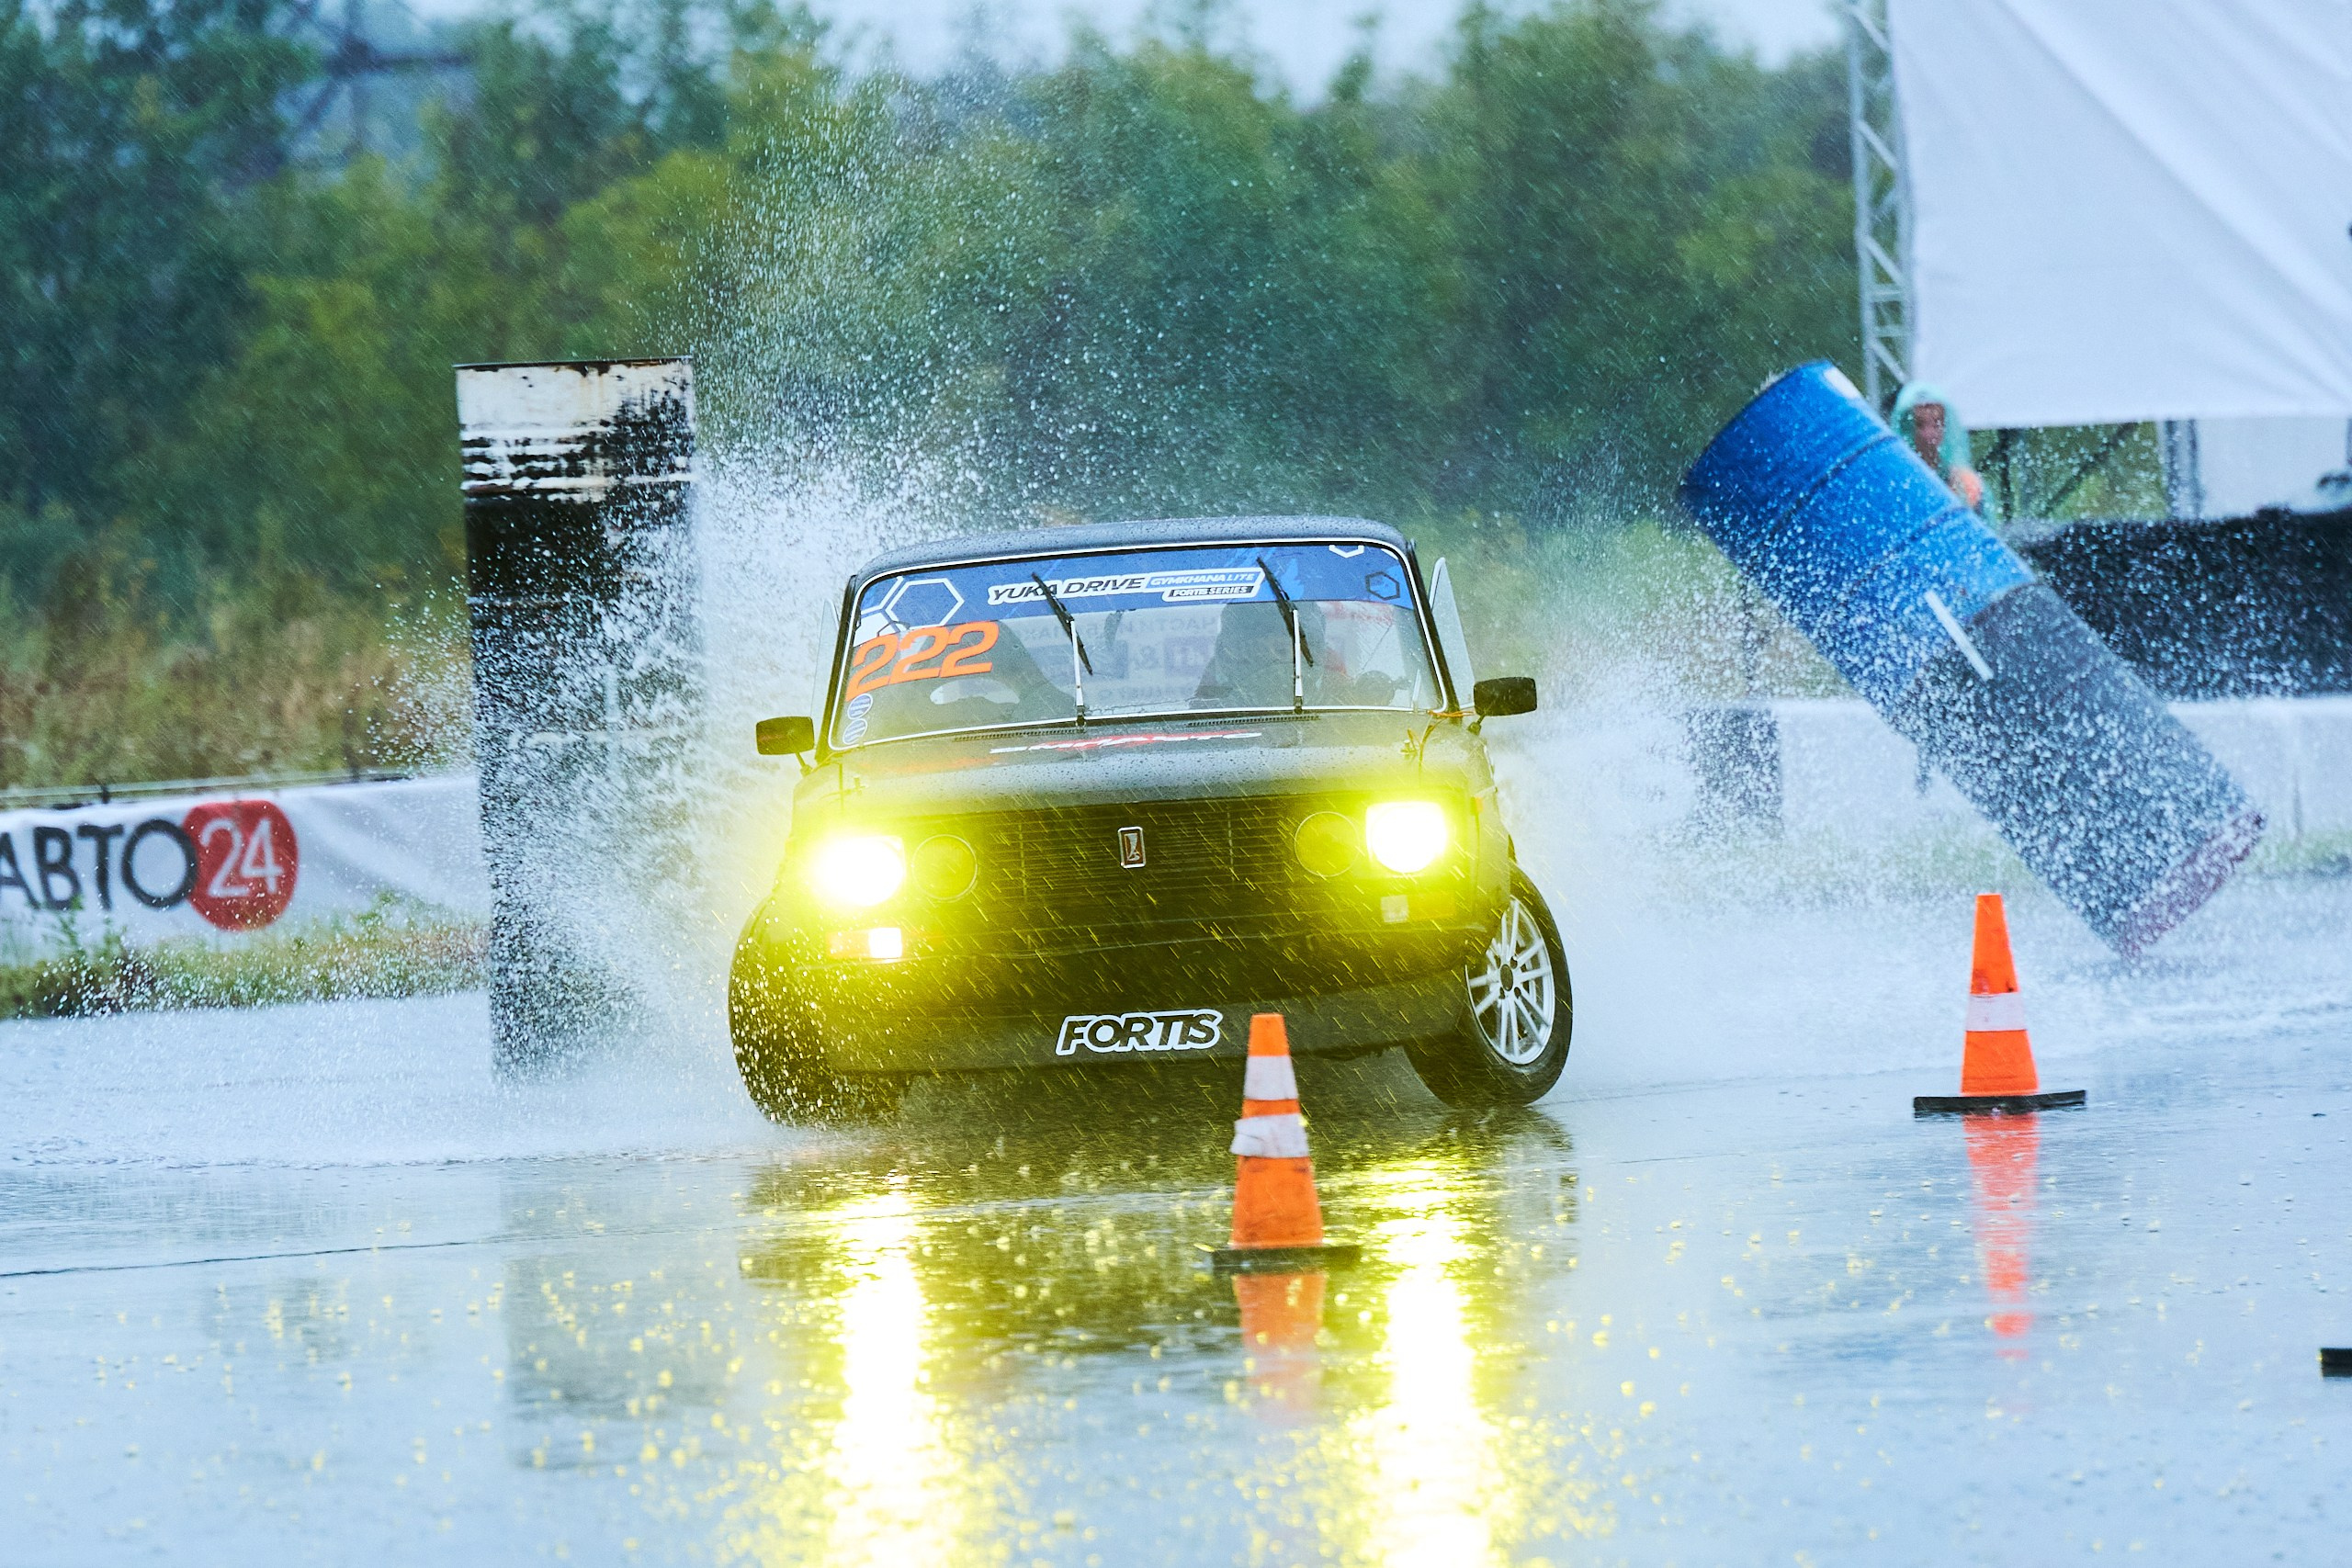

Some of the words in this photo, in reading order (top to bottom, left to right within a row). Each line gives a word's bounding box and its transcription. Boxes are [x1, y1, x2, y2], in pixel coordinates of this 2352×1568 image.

[1063, 576, 1146, 594] DRIVE
[1149, 573, 1226, 586] GYMKHANA
[1226, 572, 1255, 582] LITE
[1172, 588, 1208, 597] FORTIS
[1208, 585, 1248, 595] SERIES
[845, 620, 1000, 703] 222
[1057, 1010, 1223, 1054] FORTIS
